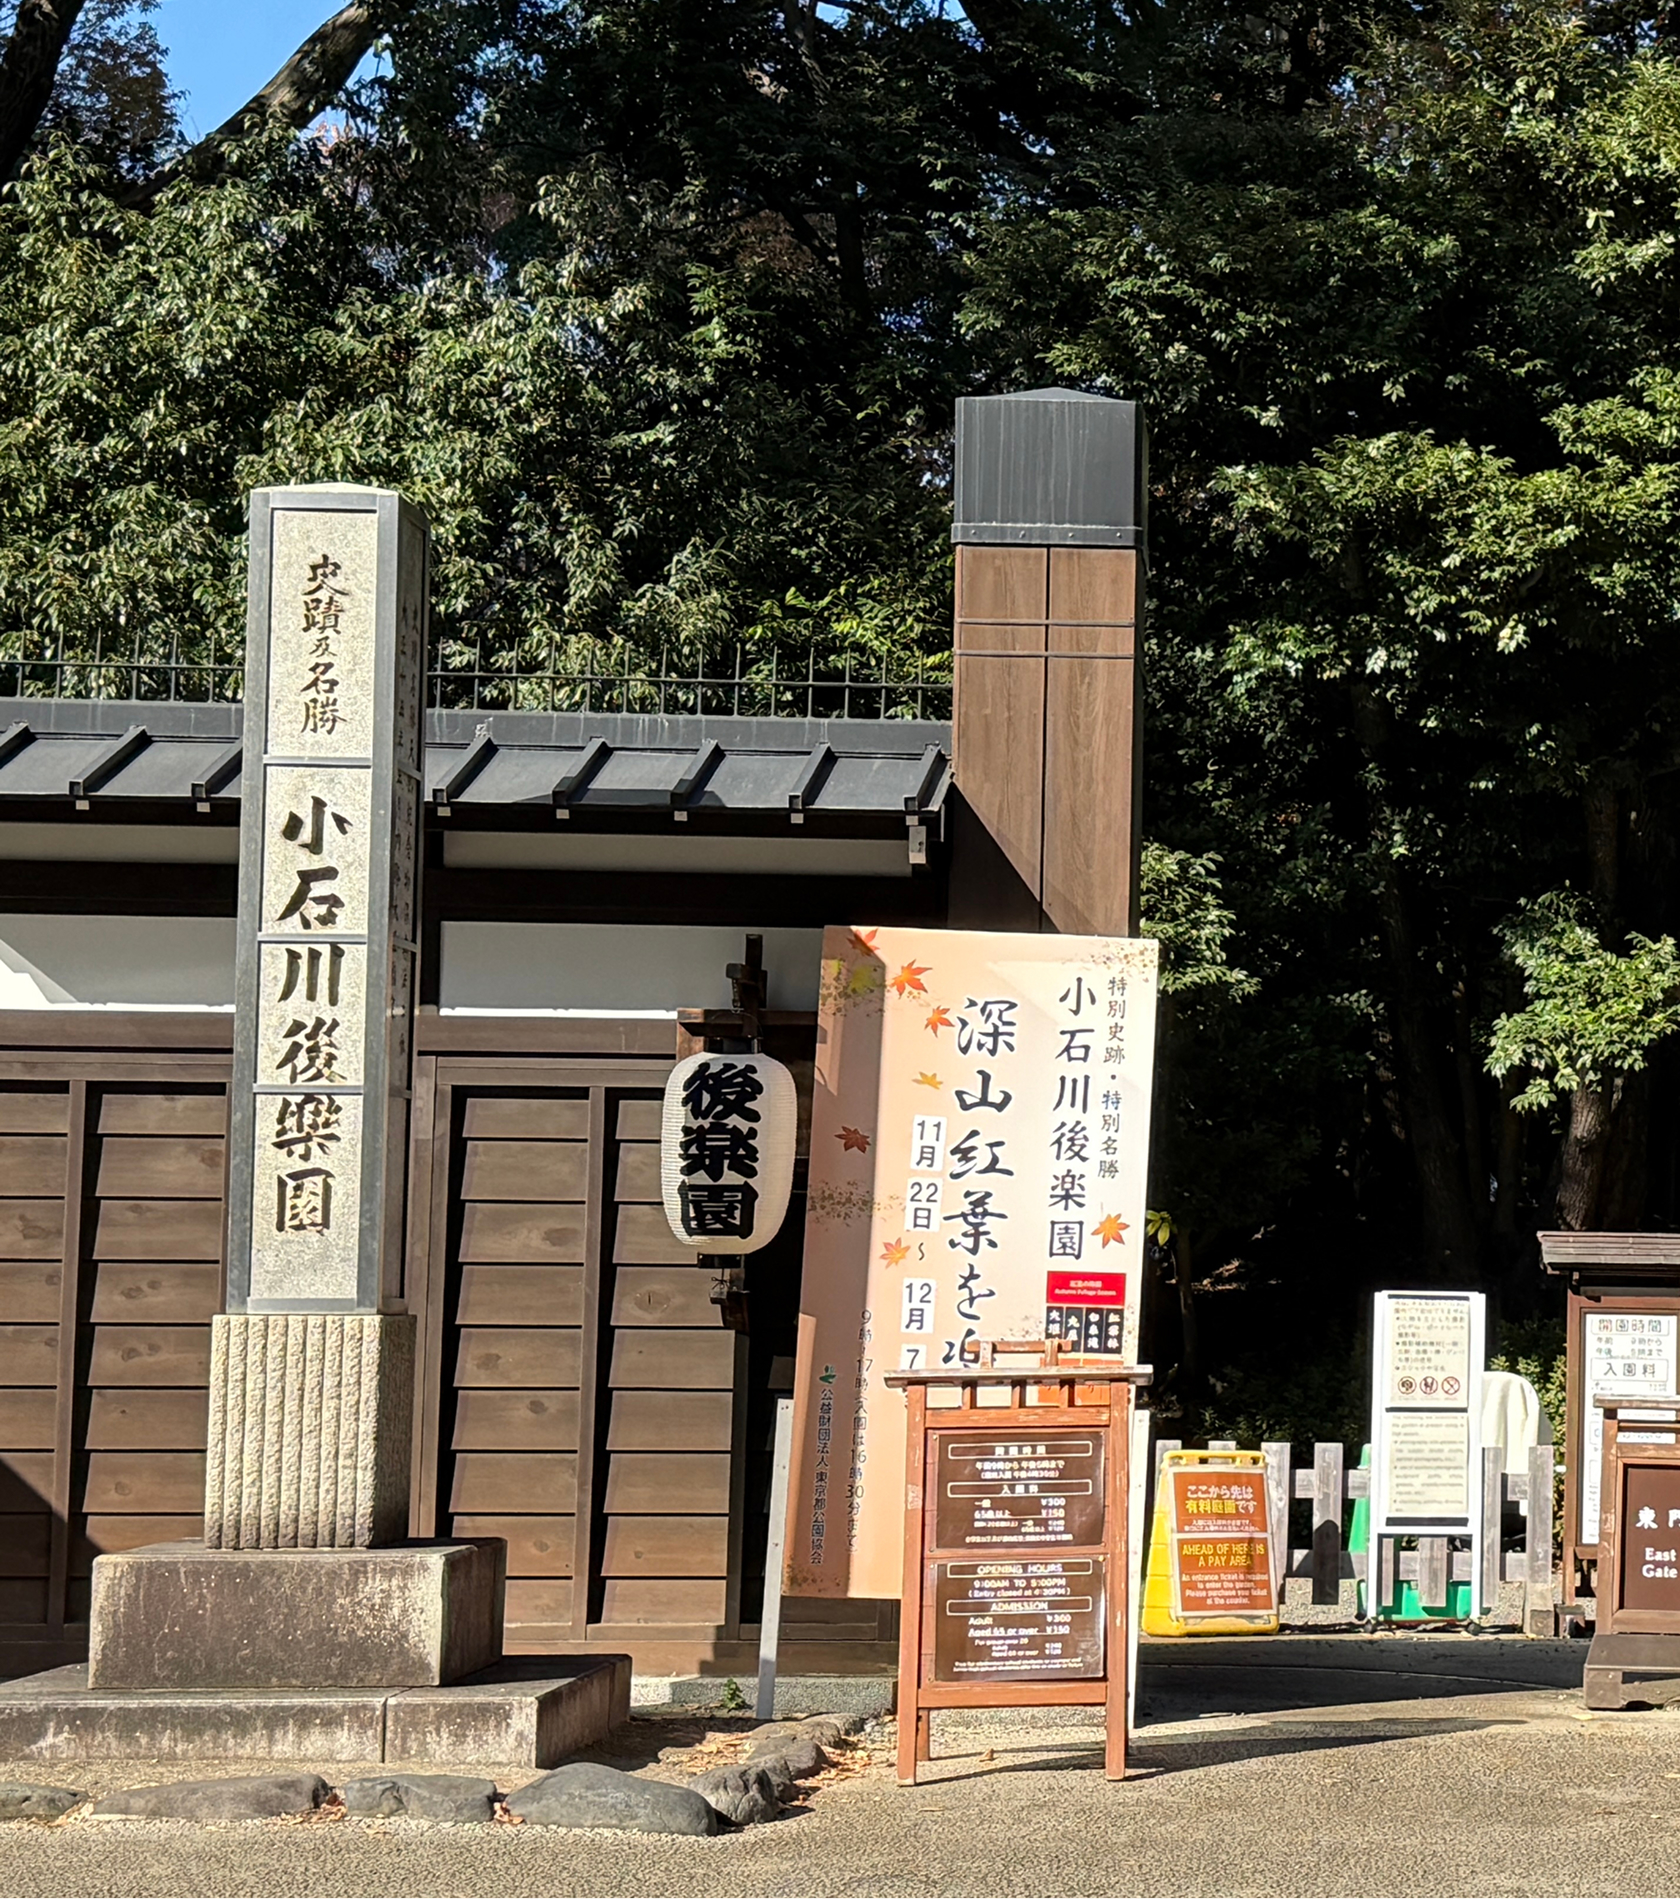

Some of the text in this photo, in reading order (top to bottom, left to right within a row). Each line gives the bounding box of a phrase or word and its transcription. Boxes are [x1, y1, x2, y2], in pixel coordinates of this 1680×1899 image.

[1047, 976, 1097, 1261] 小石川後楽園
[1603, 1362, 1656, 1378] 入園料
[1187, 1485, 1253, 1499] ここから先は
[1185, 1499, 1257, 1514] 有料庭園です
[1182, 1544, 1214, 1555] AHEAD
[1216, 1543, 1230, 1554] OF
[1256, 1543, 1265, 1554] IS
[1644, 1547, 1677, 1562] East
[1199, 1554, 1252, 1567] A PAY AREA
[977, 1563, 1064, 1574] OPENING HOURS
[1642, 1564, 1678, 1578] Gate
[973, 1579, 1010, 1588] 9:00AM
[1014, 1578, 1027, 1587] TO
[990, 1602, 1048, 1611] ADMISSION
[968, 1617, 993, 1625] Adult
